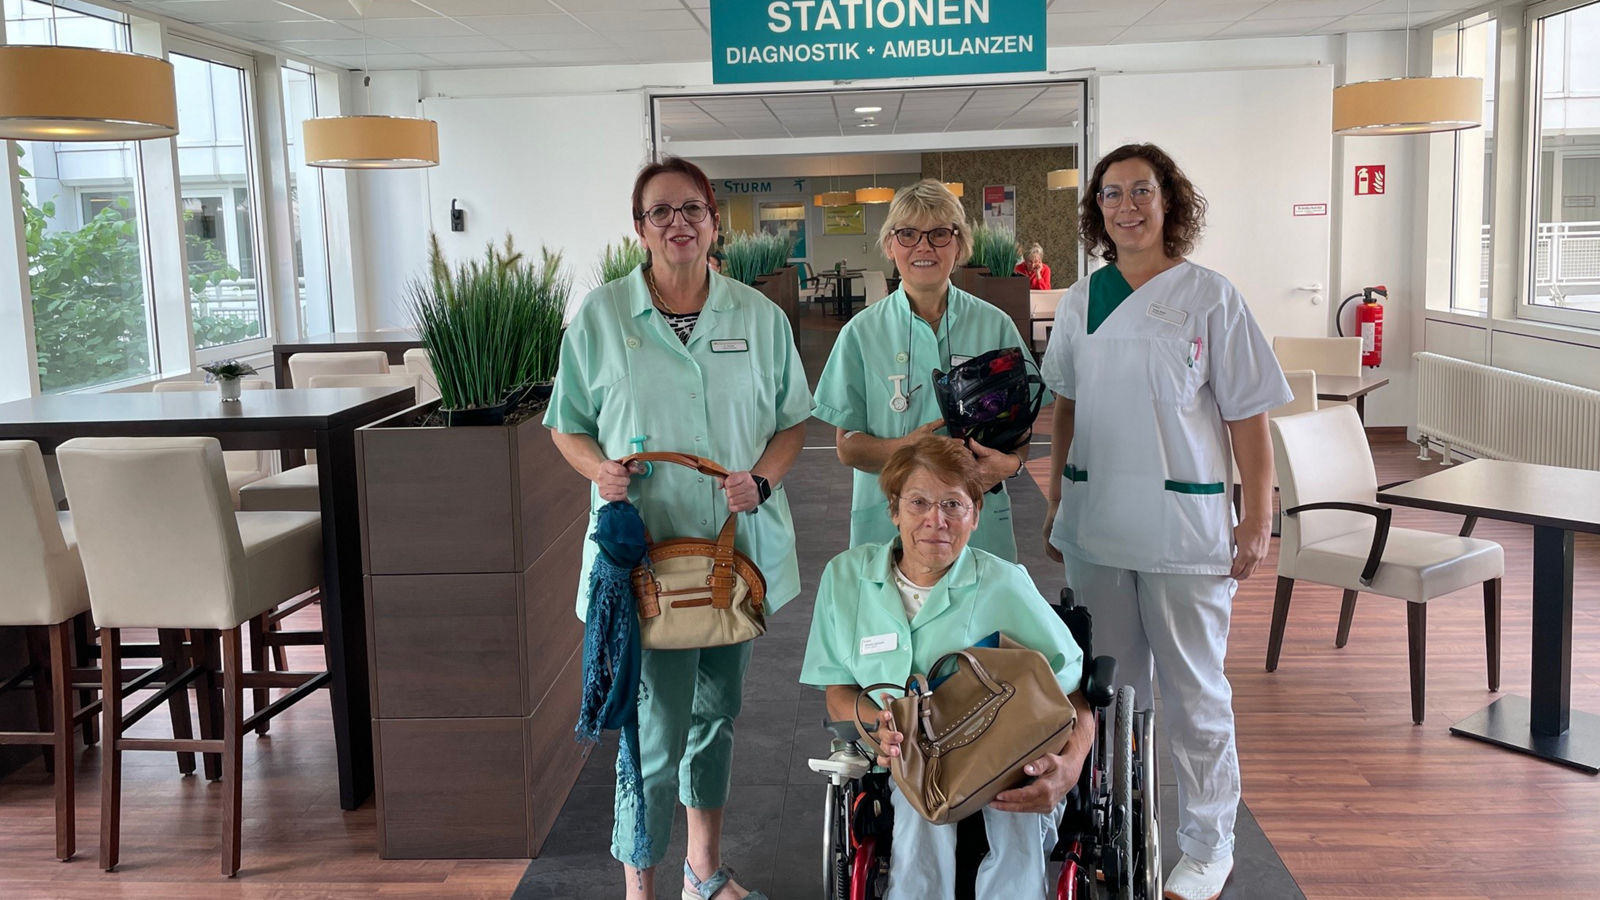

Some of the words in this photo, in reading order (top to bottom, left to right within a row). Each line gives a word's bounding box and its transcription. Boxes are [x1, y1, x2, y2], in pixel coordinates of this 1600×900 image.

[767, 0, 990, 33] STATIONEN
[726, 43, 860, 65] DIAGNOSTIK
[882, 35, 1034, 59] AMBULANZEN
